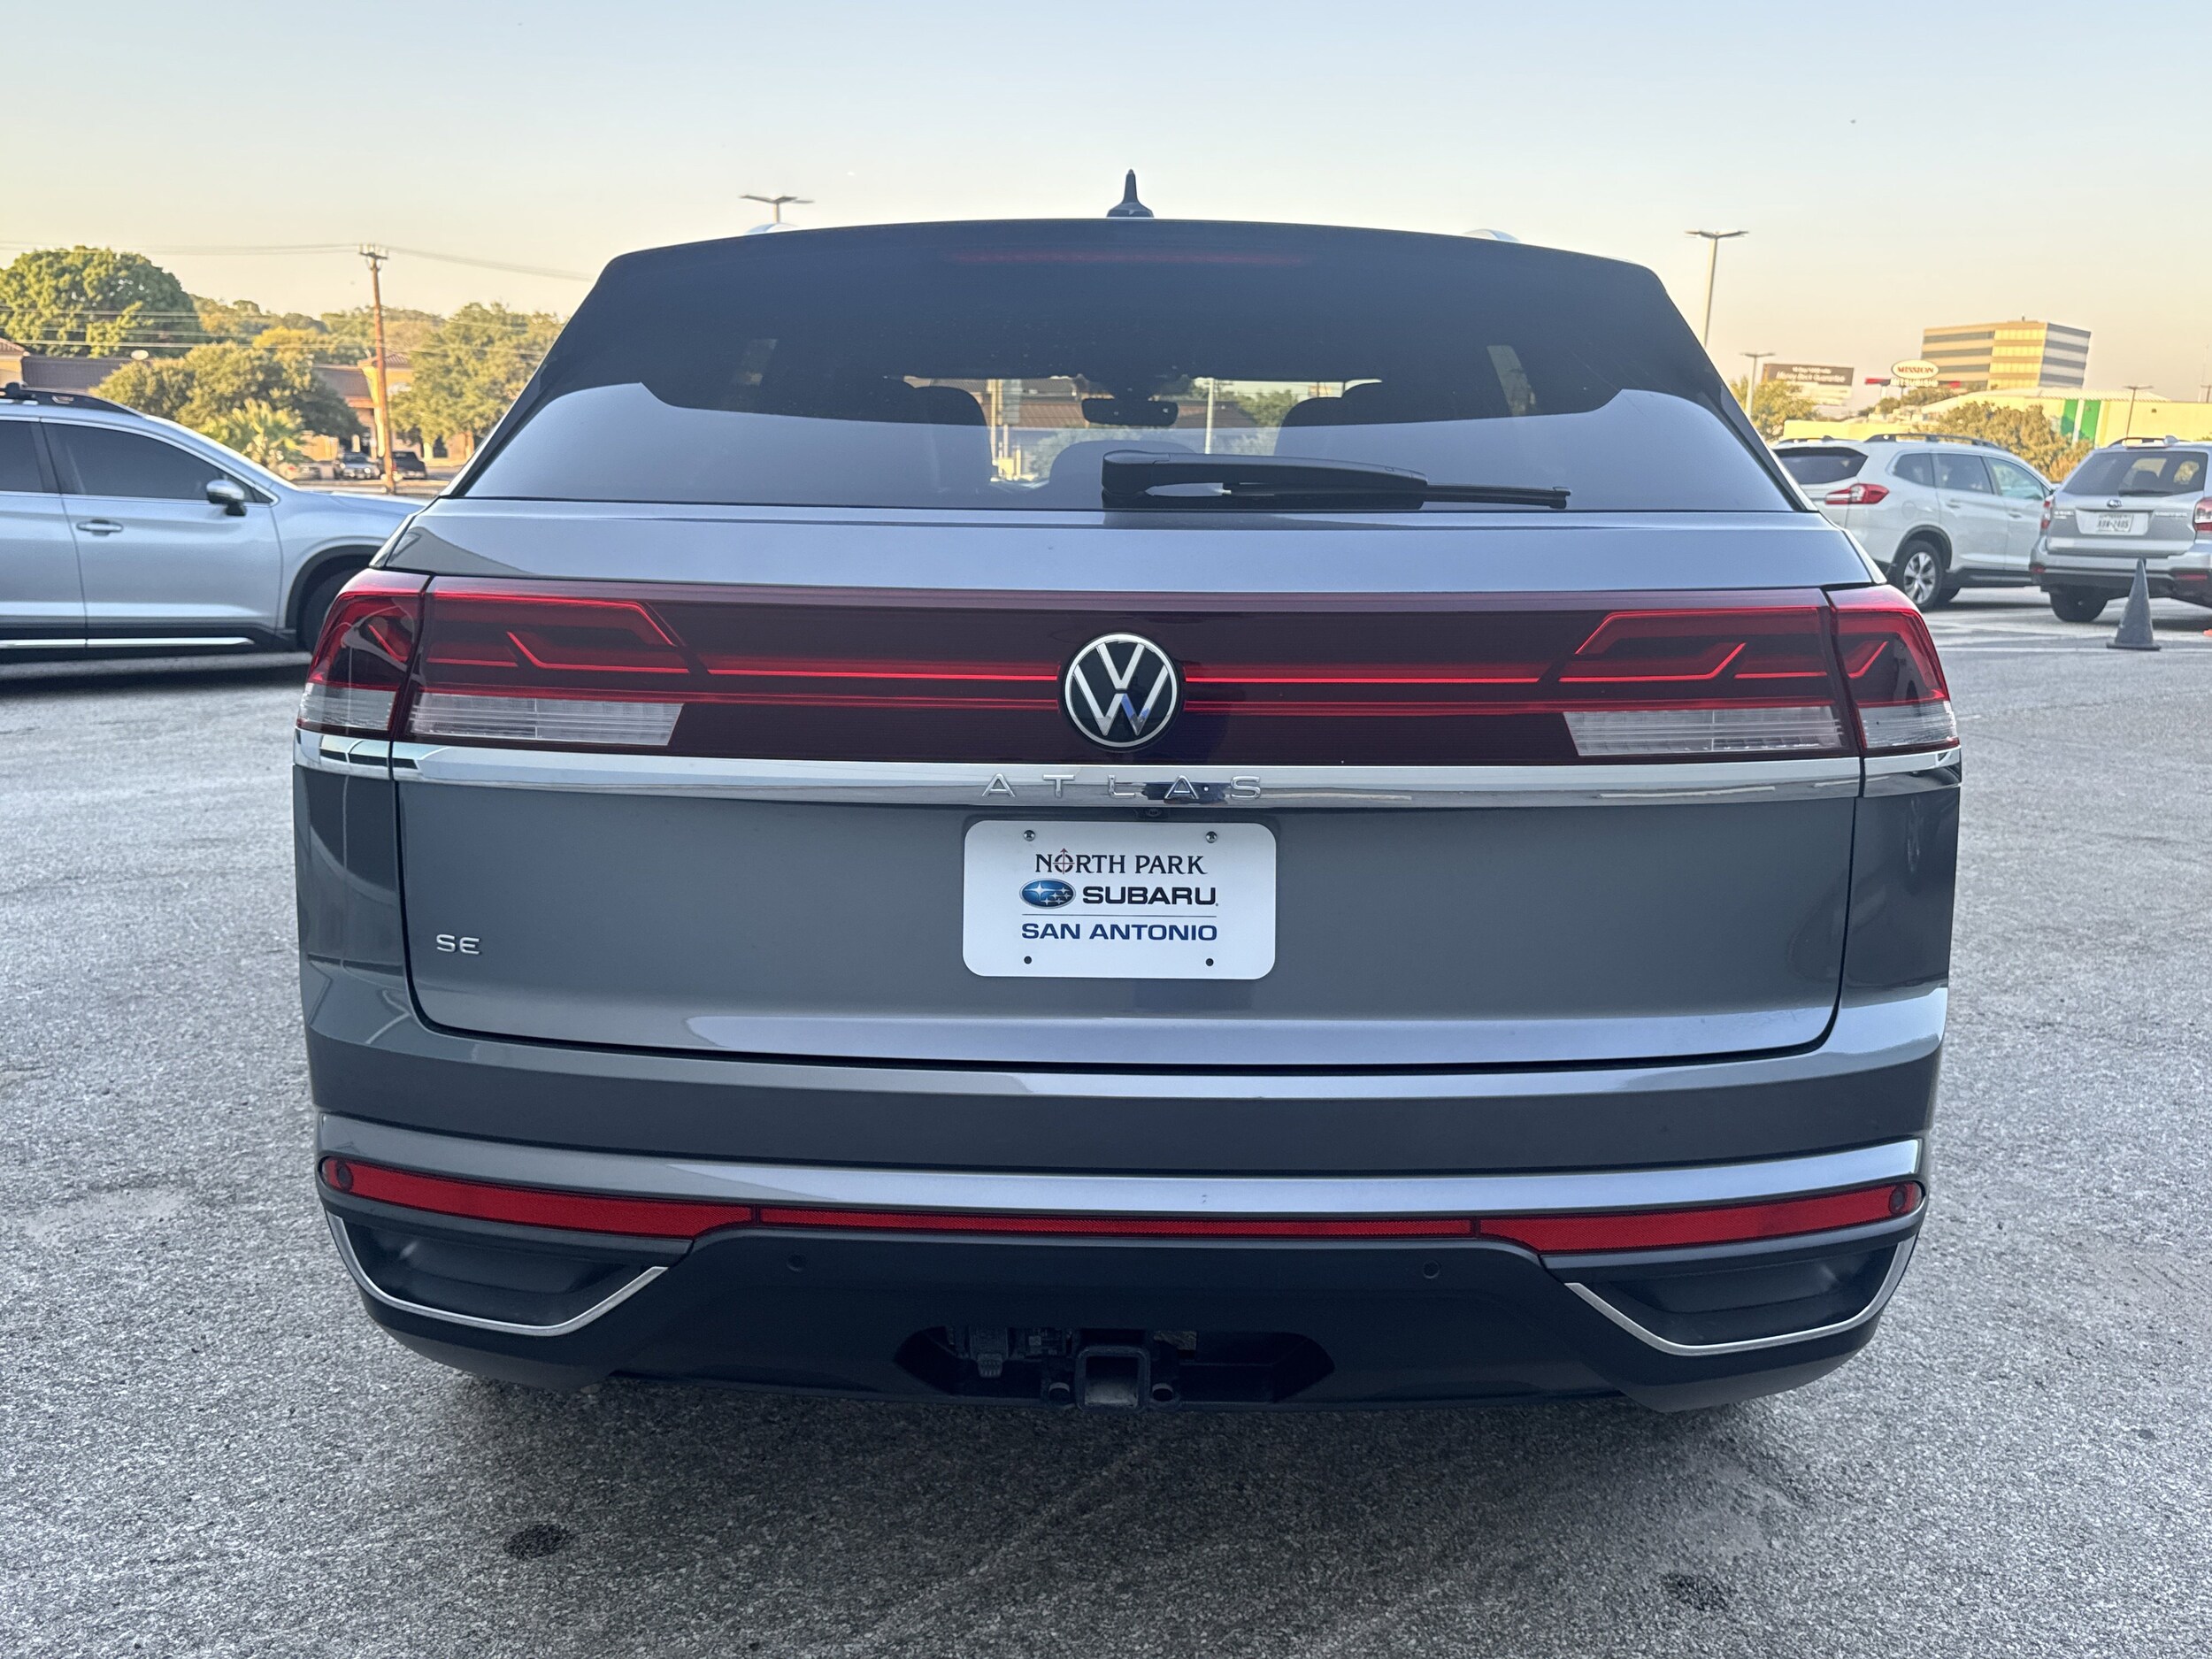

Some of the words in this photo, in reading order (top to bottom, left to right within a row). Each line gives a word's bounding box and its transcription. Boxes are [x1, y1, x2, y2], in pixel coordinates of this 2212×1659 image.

[981, 772, 1262, 800] ATLAS
[1035, 851, 1125, 874] NORTH
[1135, 855, 1208, 875] PARK
[1082, 886, 1217, 905] SUBARU
[1021, 923, 1081, 940] SAN
[1089, 924, 1217, 941] ANTONIO
[436, 933, 480, 955] SE
